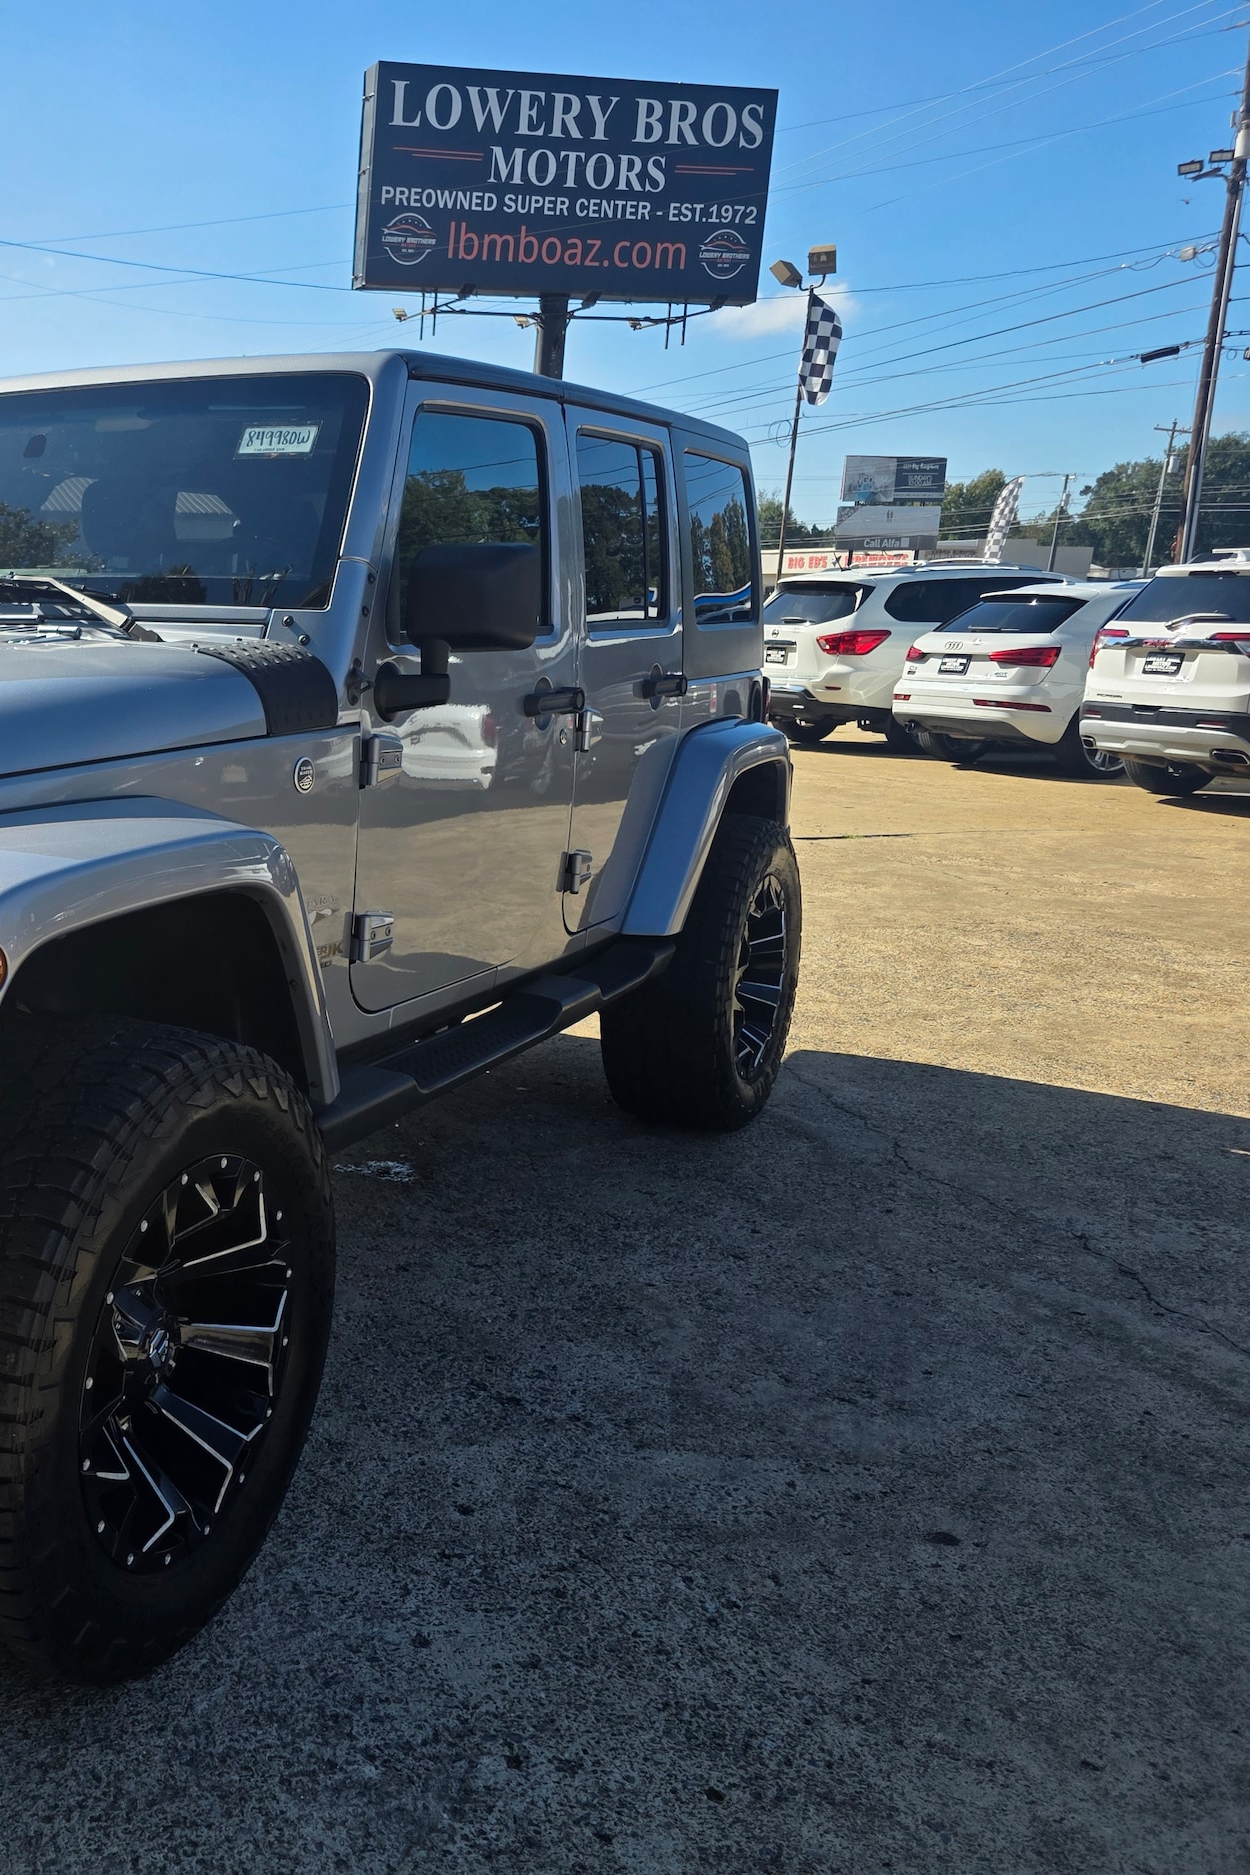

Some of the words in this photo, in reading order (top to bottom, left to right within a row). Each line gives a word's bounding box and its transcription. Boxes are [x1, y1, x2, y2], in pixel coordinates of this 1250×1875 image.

[388, 79, 620, 141] LOWERY
[631, 98, 765, 149] BROS
[487, 145, 666, 193] MOTORS
[381, 185, 498, 212] PREOWNED
[503, 193, 570, 216] SUPER
[575, 198, 651, 221] CENTER
[447, 221, 687, 270] lbmboaz.com
[787, 557, 805, 569] BIG
[863, 539, 881, 548] Call
[882, 538, 900, 548] Alfa
